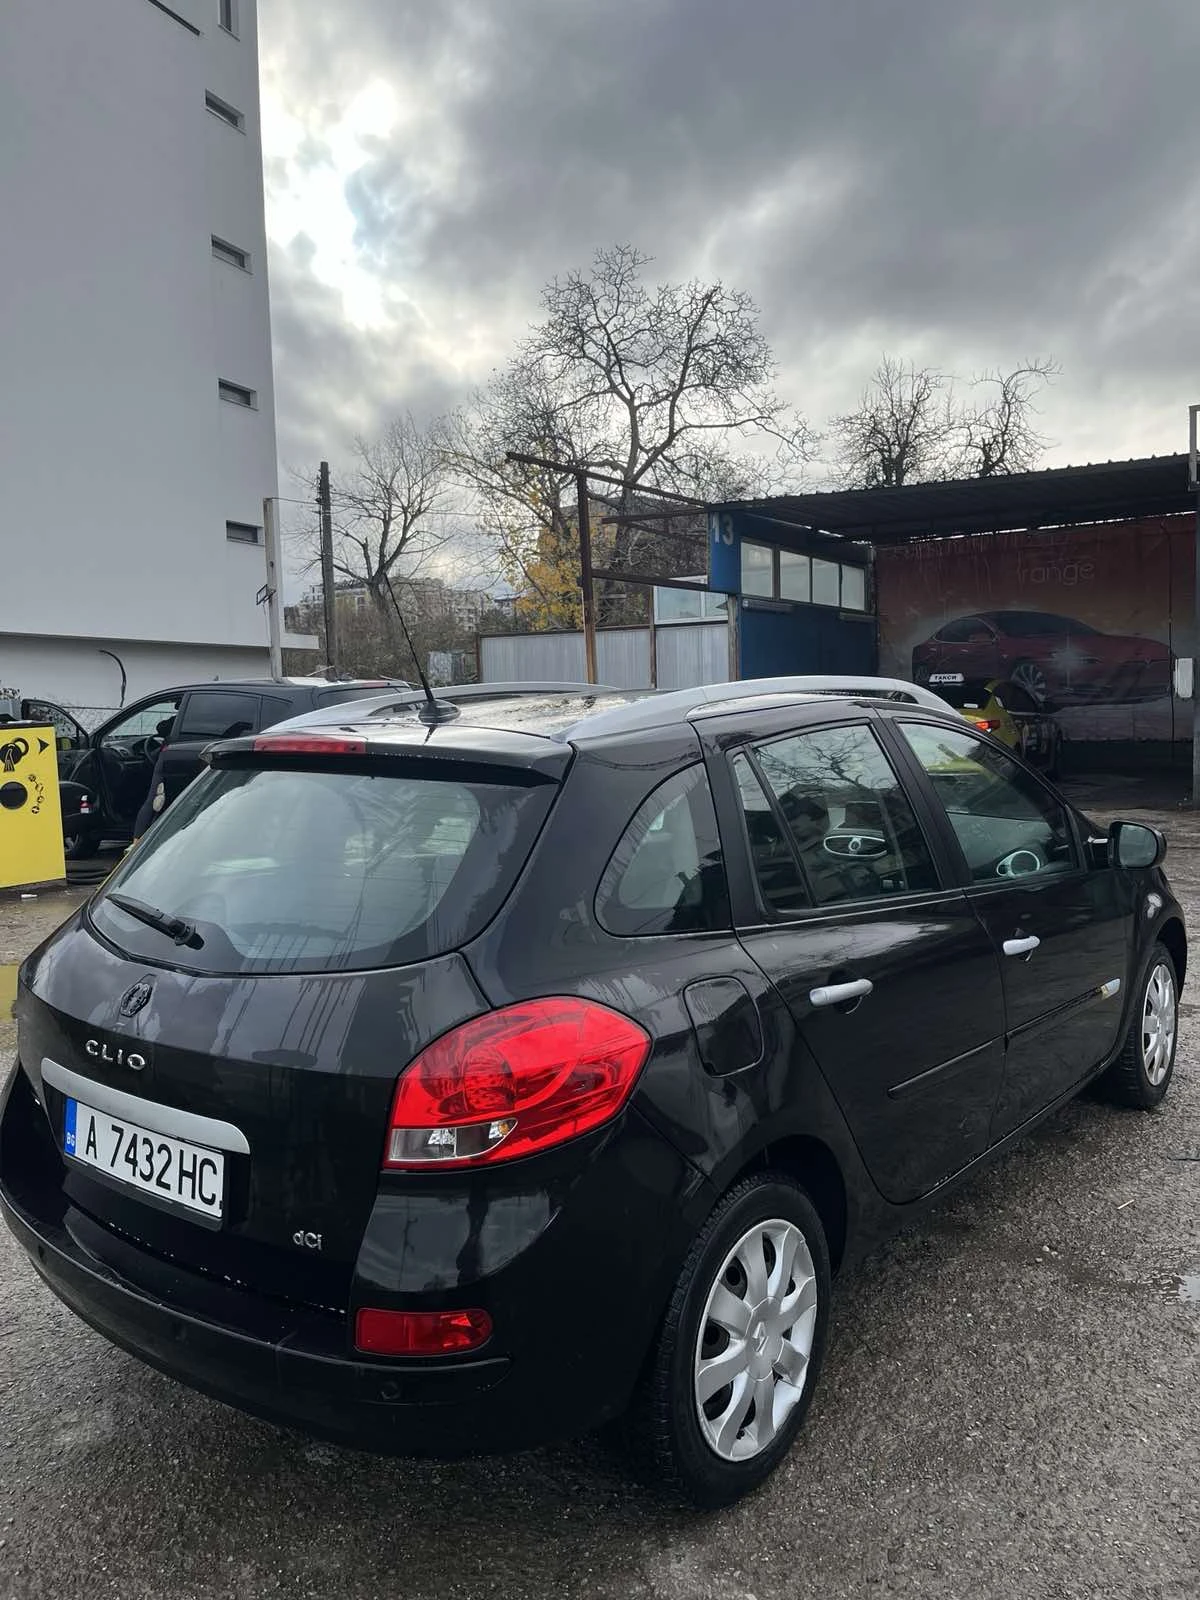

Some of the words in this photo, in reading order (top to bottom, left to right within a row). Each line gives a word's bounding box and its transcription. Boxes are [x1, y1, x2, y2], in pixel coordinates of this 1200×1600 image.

[711, 511, 733, 545] 13
[85, 1039, 145, 1071] CLIO
[66, 1132, 76, 1147] BG
[292, 1230, 322, 1251] dCi
